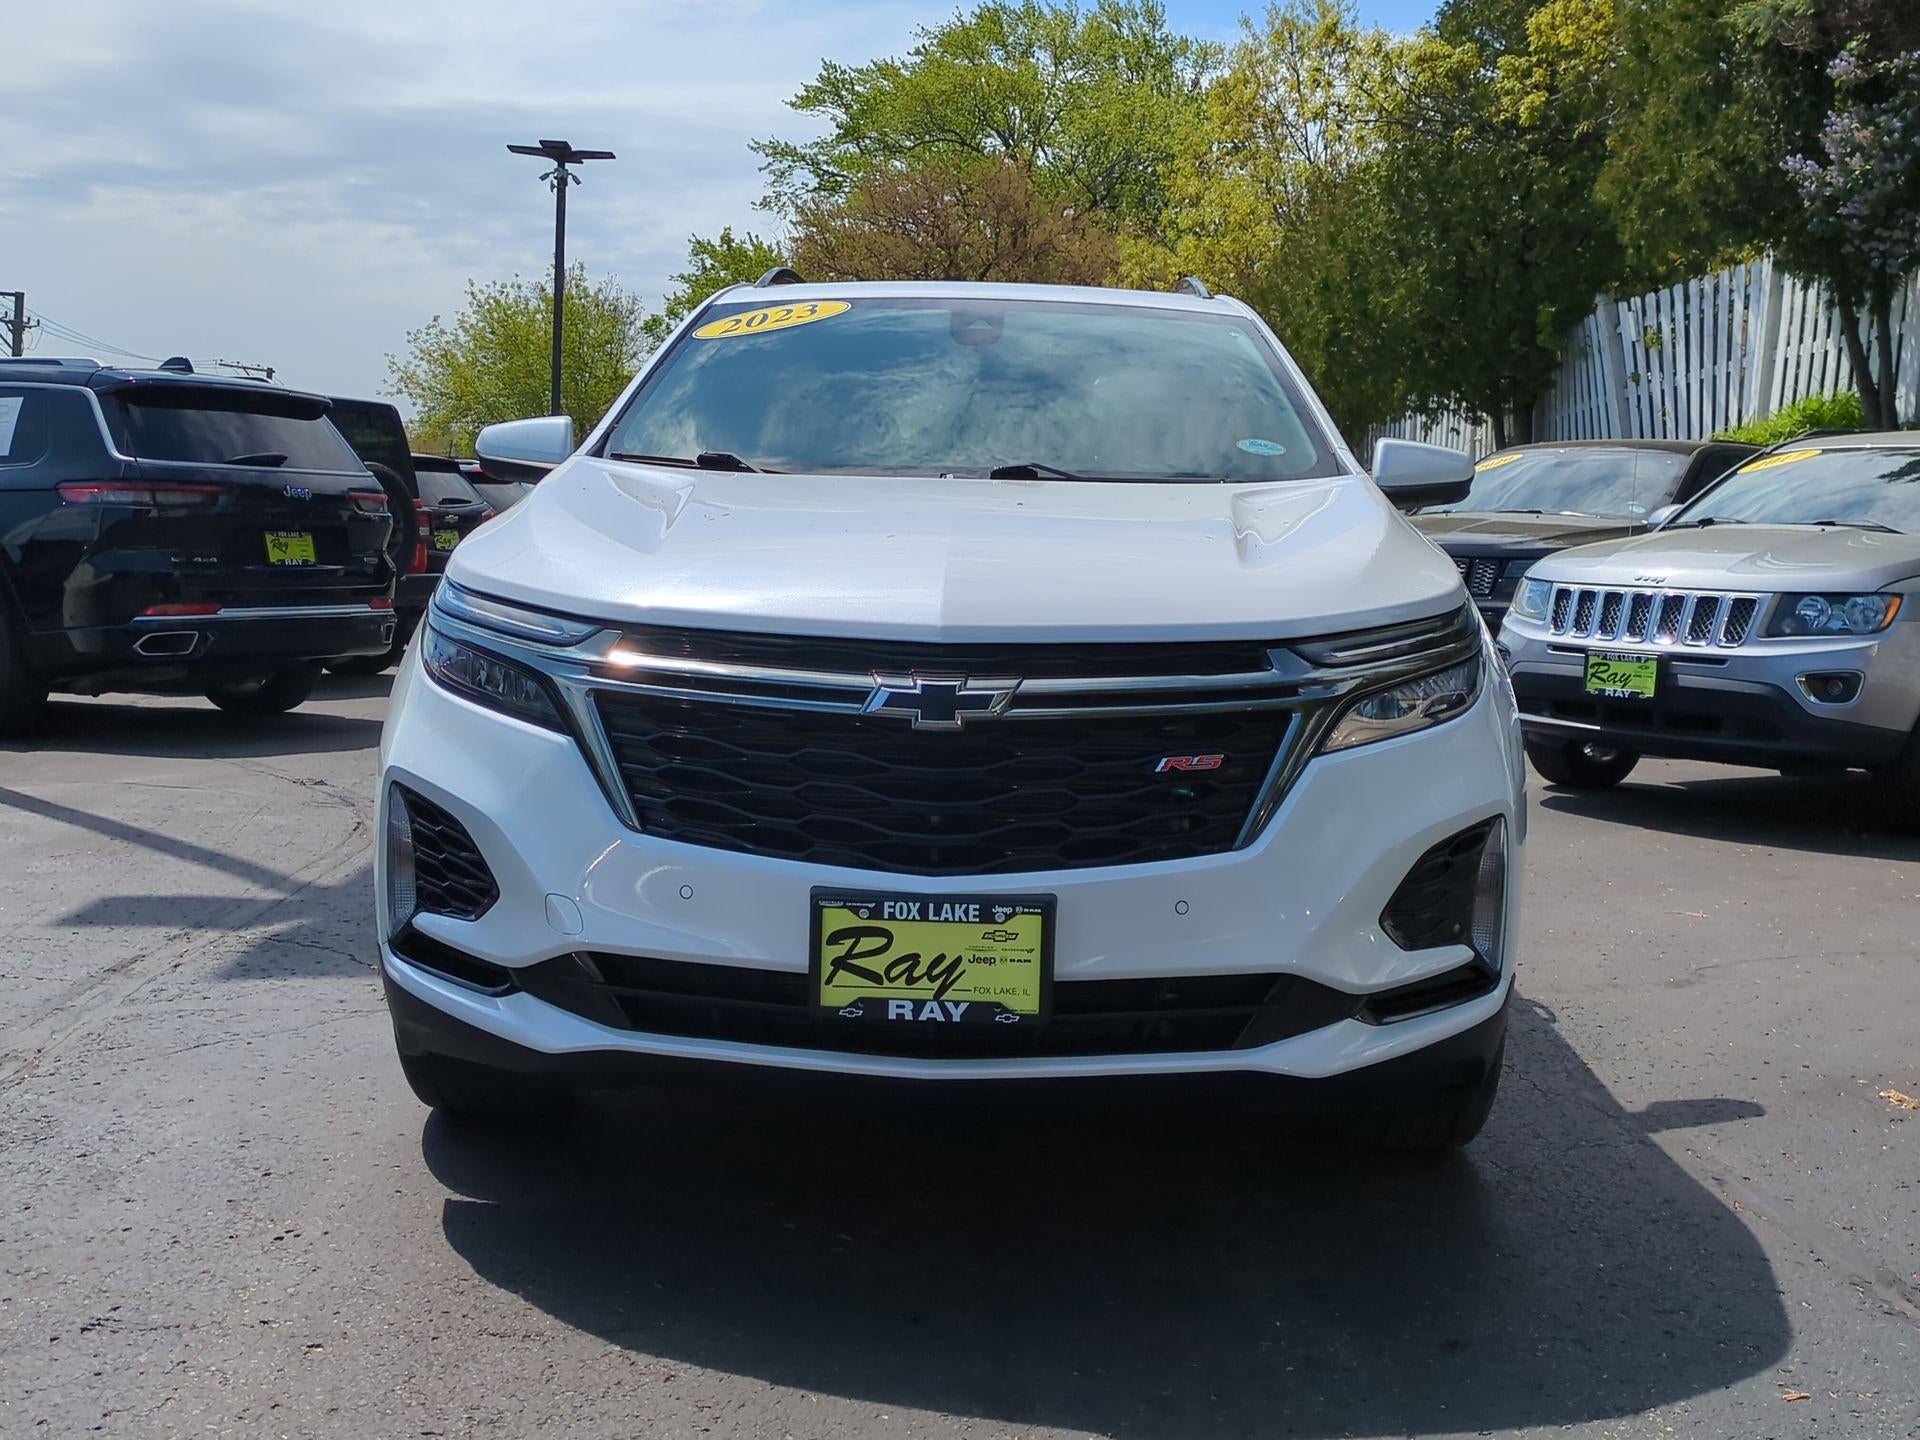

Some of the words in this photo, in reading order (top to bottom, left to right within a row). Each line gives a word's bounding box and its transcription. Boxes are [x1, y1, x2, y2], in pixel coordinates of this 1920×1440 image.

[719, 303, 819, 335] 2023
[283, 485, 312, 501] Jeep
[1588, 662, 1632, 689] Ray
[1605, 688, 1632, 698] RAY
[1155, 754, 1225, 773] RS
[883, 901, 921, 921] FOX
[928, 903, 980, 923] LAKE
[992, 904, 1013, 915] Jeep
[824, 926, 967, 1001] Ray
[967, 953, 997, 967] Jeep
[973, 986, 991, 995] FOX
[994, 987, 1020, 997] LAKE,
[887, 1000, 970, 1023] RAY
